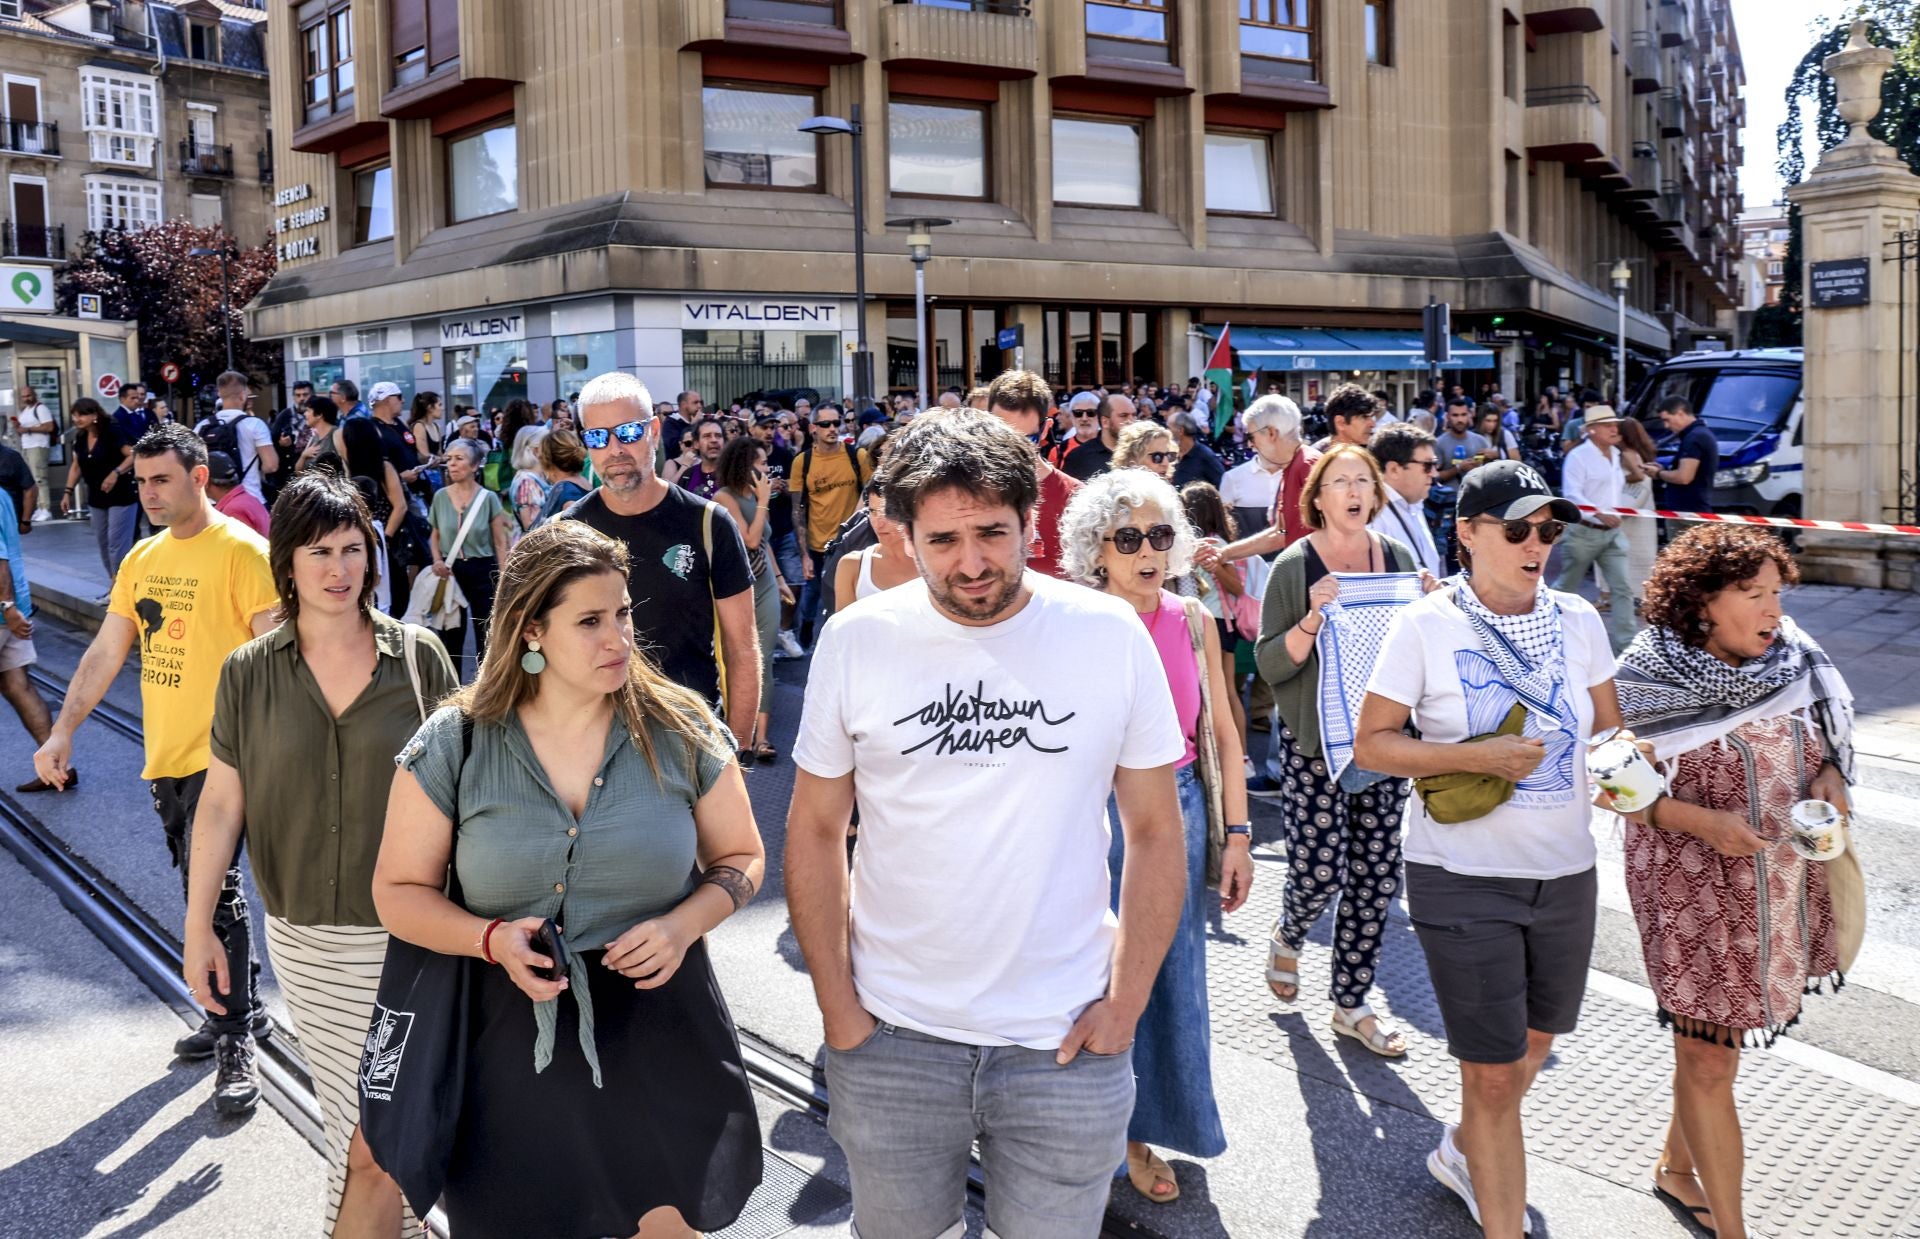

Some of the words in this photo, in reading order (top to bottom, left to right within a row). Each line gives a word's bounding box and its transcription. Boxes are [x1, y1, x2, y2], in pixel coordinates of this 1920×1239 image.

[275, 184, 307, 206] AGENCIA
[275, 217, 286, 234] DE
[289, 206, 326, 229] SEGUROS
[686, 303, 836, 321] VITALDENT
[441, 315, 521, 339] VITALDENT
[1514, 466, 1545, 490] NY
[145, 575, 182, 586] CUANDO
[184, 578, 198, 588] NO
[153, 643, 186, 656] ELLOS
[893, 680, 1075, 728] askatasun
